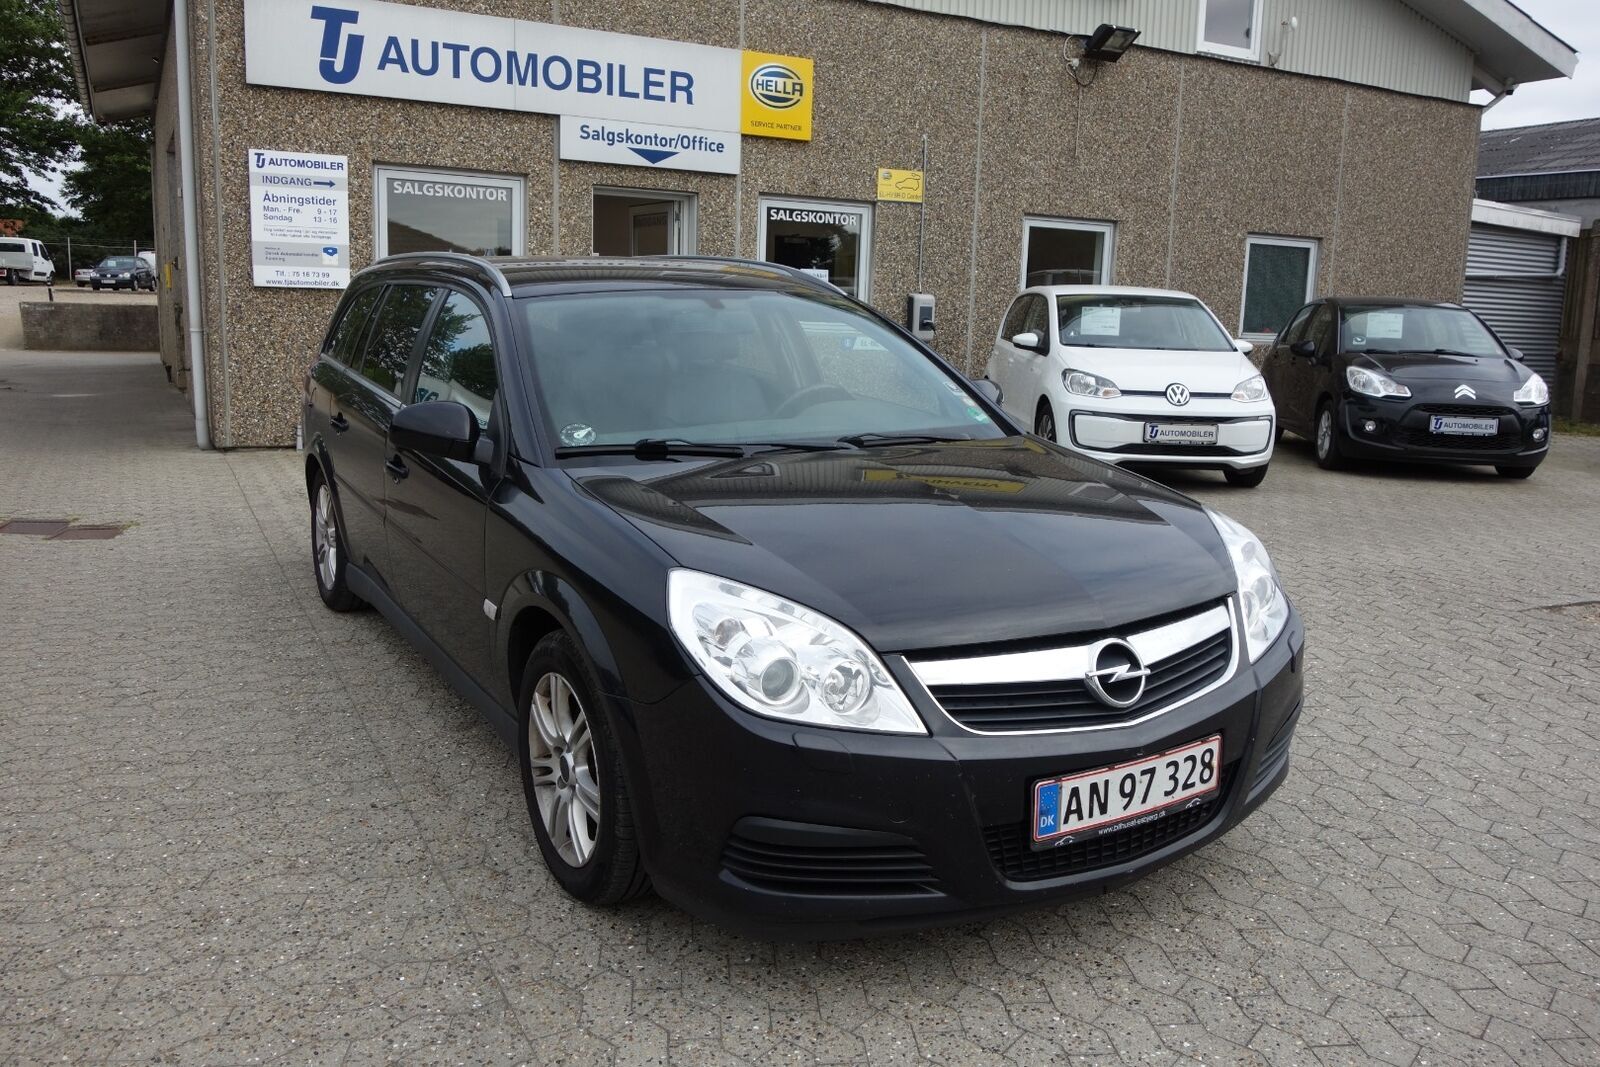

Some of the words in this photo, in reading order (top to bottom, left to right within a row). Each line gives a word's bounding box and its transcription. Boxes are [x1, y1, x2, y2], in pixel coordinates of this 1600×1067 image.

[310, 4, 365, 86] TJ
[376, 34, 694, 106] AUTOMOBILER
[755, 78, 804, 97] HELLA
[750, 120, 775, 129] SERVICE
[776, 123, 802, 132] PARTNER
[579, 124, 725, 154] Salgskontor/Office
[268, 157, 344, 171] AUTOMOBILER
[262, 175, 312, 187] INDGANG
[263, 190, 337, 207] Åbningstider
[393, 181, 507, 202] SALGSKONTOR
[263, 213, 293, 223] Søndag
[770, 208, 857, 226] SALGSKONTOR
[1159, 430, 1214, 438] AUTOMOBILER
[1443, 422, 1495, 431] AUTOMOBILER
[1063, 779, 1110, 825] AN
[1119, 766, 1157, 811] 97
[1164, 747, 1215, 797] 328
[1040, 814, 1055, 828] DK
